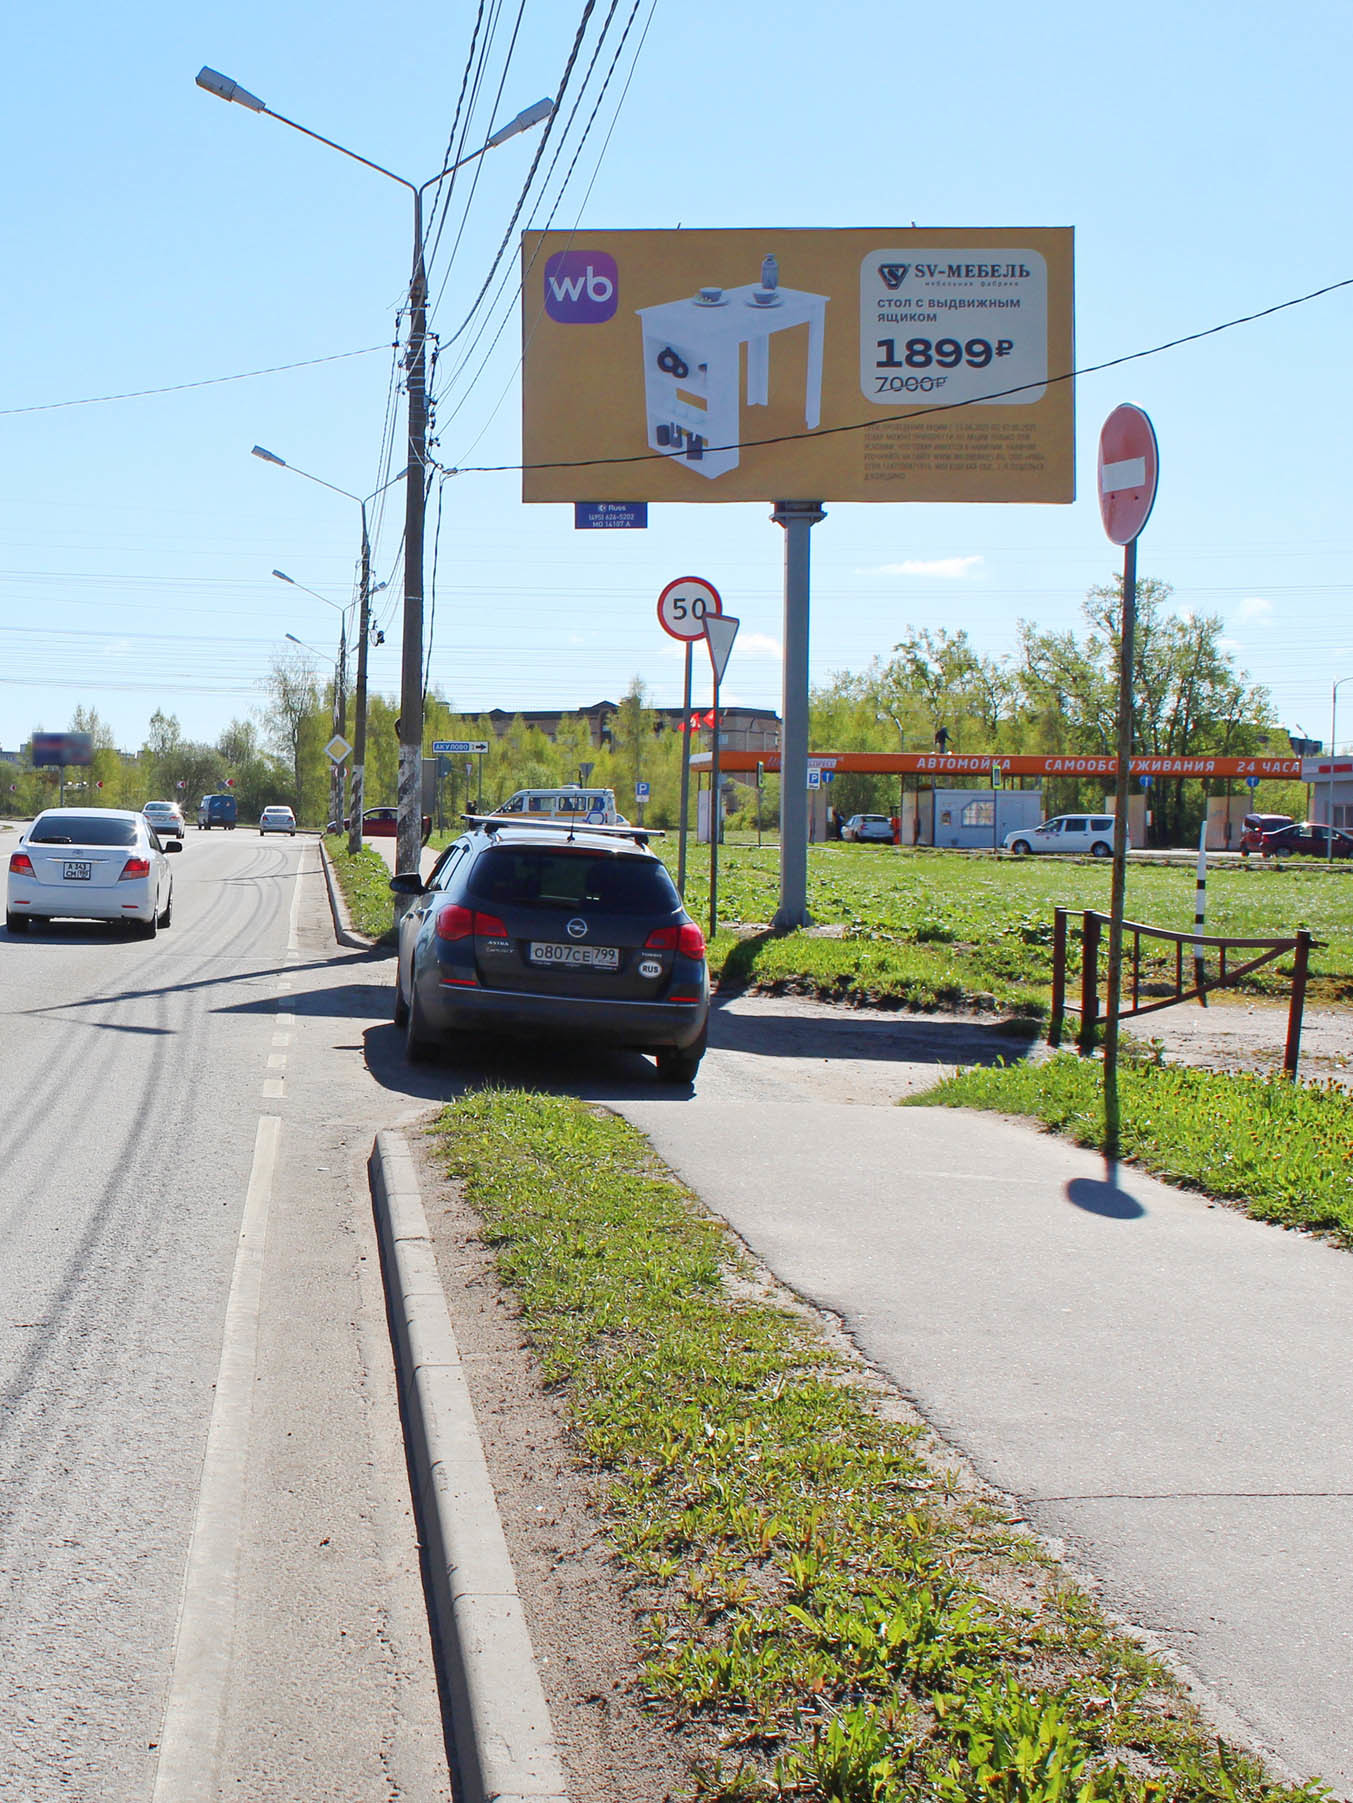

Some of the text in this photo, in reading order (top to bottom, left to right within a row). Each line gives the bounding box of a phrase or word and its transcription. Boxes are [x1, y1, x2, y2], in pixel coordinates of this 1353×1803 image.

[914, 263, 1031, 279] SV-МЕБЕЛЬ
[548, 265, 613, 303] wb
[608, 504, 627, 512] Russ
[672, 597, 706, 620] 50
[916, 757, 1300, 773] АВТОМОЙКА САМООБСУЖИВАНИЯ 24 ЧАСА
[534, 945, 615, 963] О807СЕ 799
[642, 965, 659, 974] RUS
